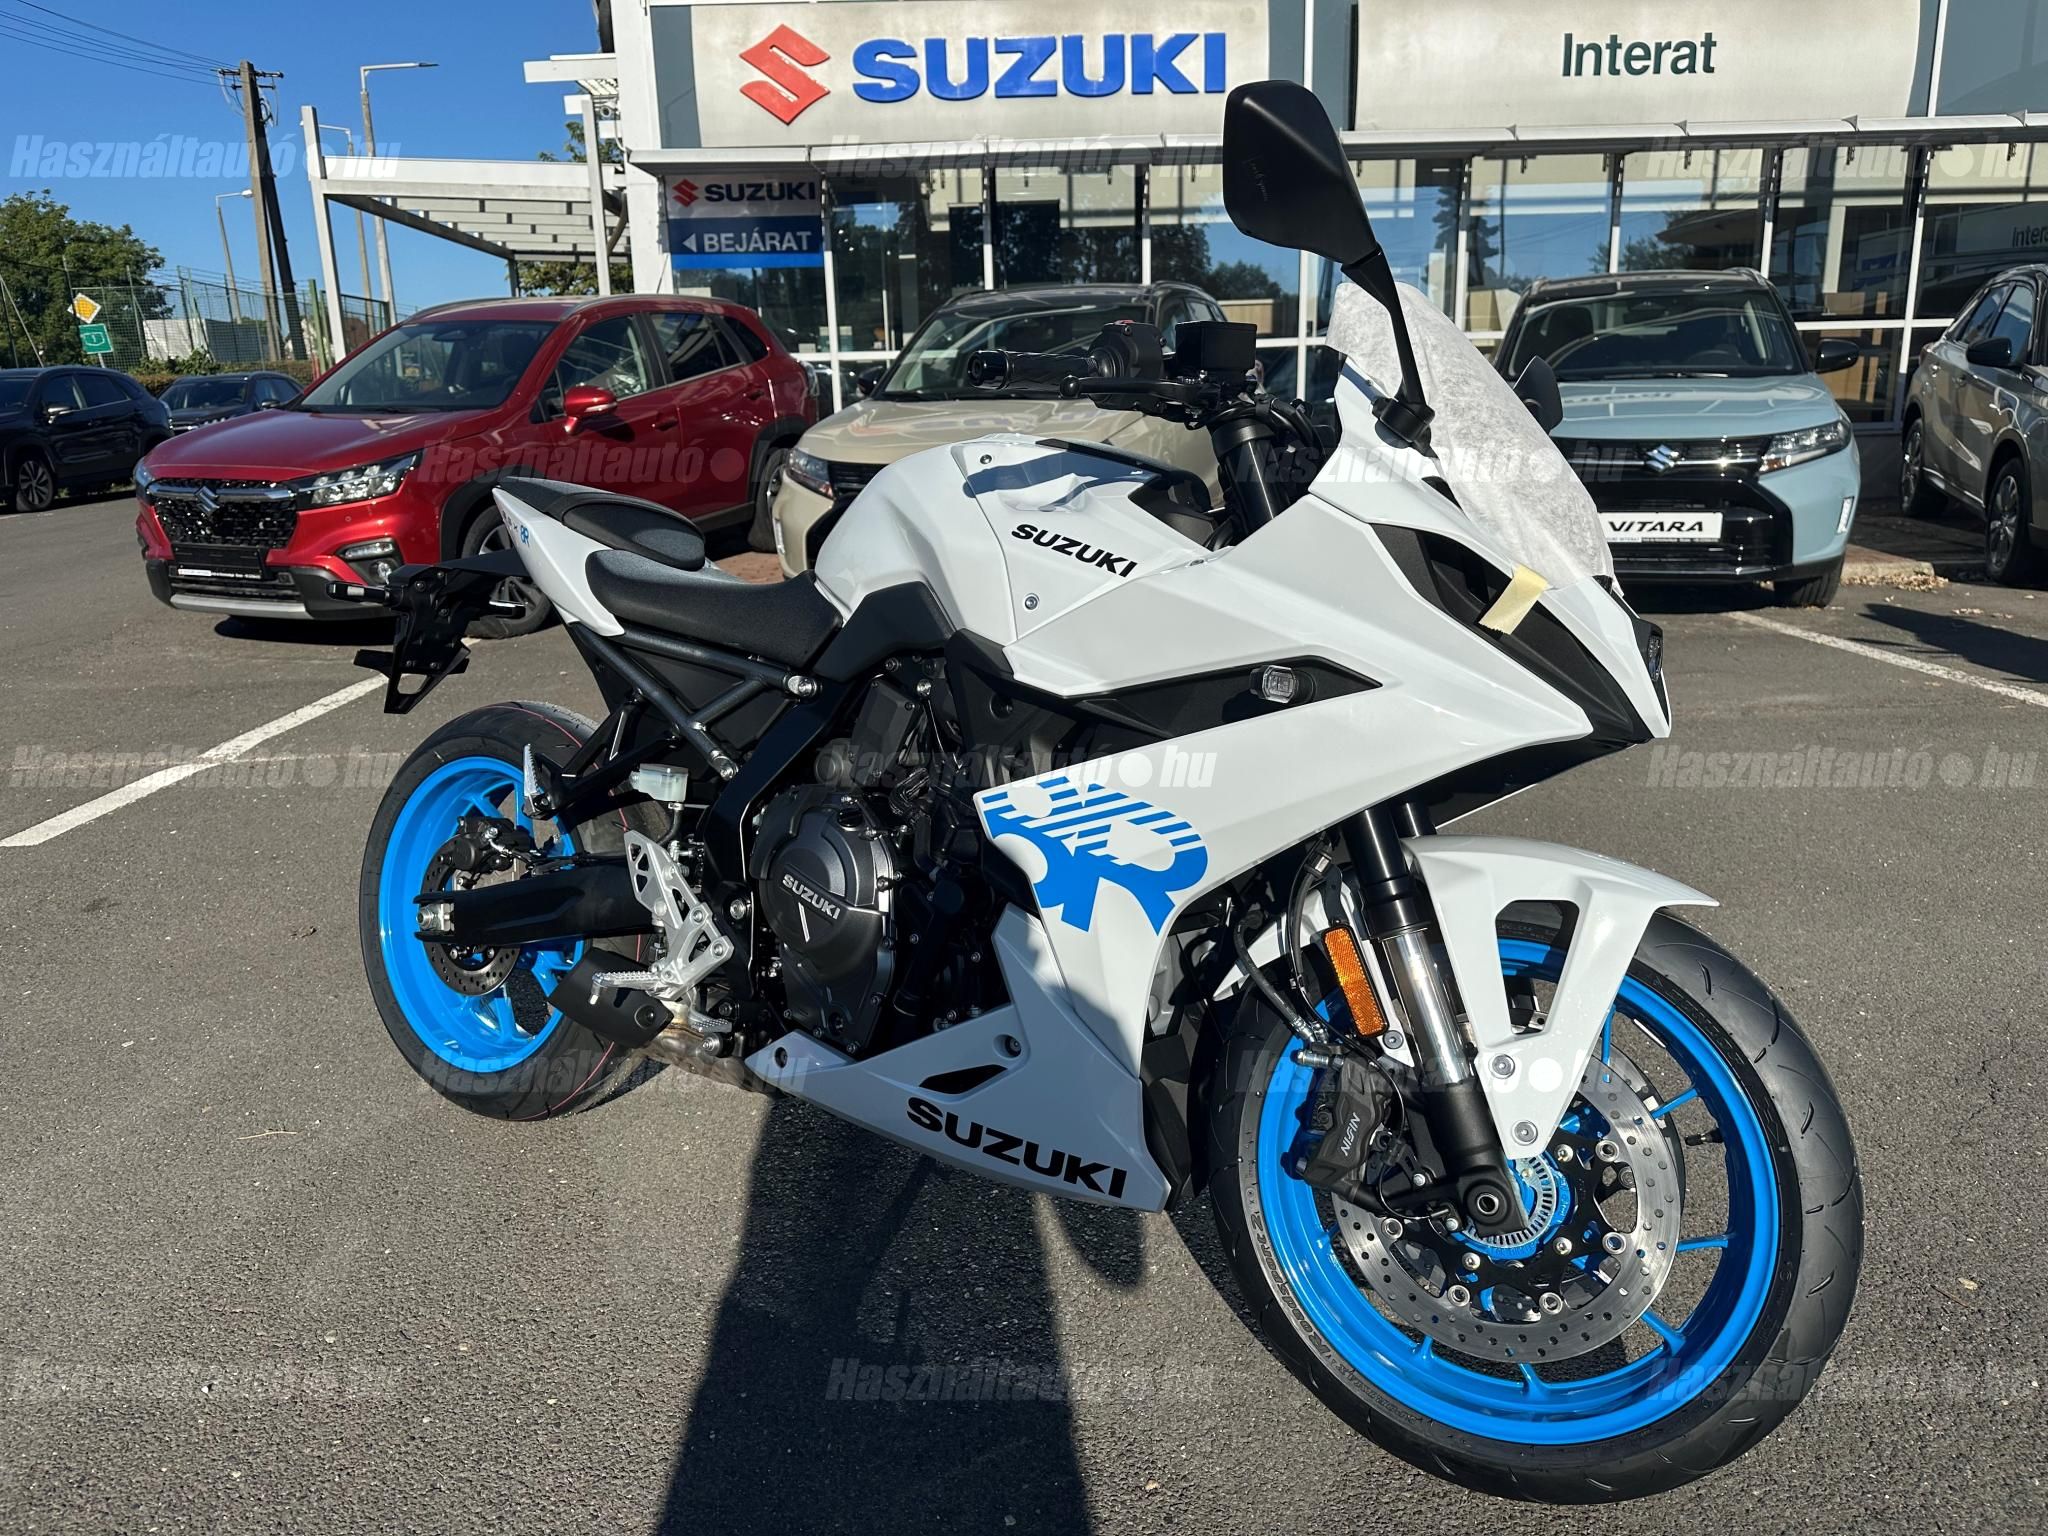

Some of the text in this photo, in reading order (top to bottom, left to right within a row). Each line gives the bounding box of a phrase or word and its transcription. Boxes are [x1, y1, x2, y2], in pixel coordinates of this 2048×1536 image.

[852, 32, 1226, 103] SUZUKI
[1562, 32, 1717, 77] Interat
[704, 181, 816, 203] SUZUKI
[703, 227, 812, 253] BEJÁRAT
[1608, 521, 1703, 532] VITARA
[1011, 524, 1138, 578] SUZUKI
[782, 873, 841, 920] SUZUKI
[906, 1096, 1128, 1199] SUZUKI
[1340, 1112, 1361, 1157] NISSIN
